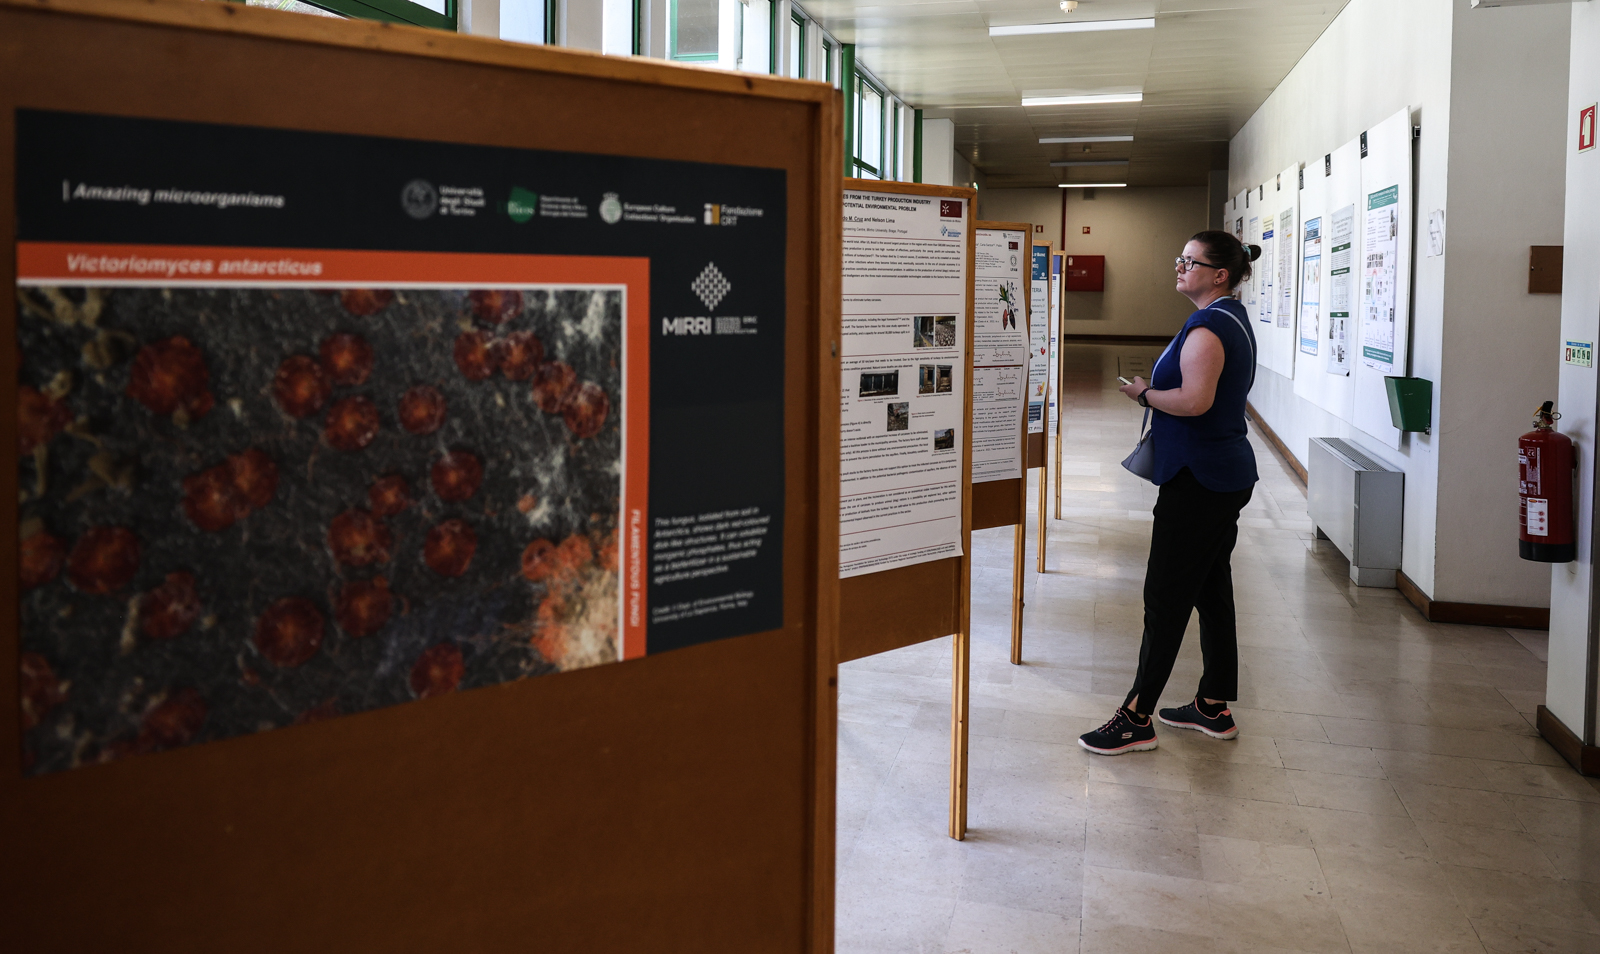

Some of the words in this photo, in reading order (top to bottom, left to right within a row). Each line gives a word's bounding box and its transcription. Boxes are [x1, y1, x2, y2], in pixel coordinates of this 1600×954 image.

[74, 182, 150, 205] Amazing
[154, 188, 285, 208] microorganisms
[721, 204, 764, 216] Fondazione
[67, 254, 214, 277] Victoriomyces
[218, 258, 324, 276] antarcticus
[662, 316, 712, 336] MIRRI
[630, 509, 641, 590] FILAMENTOUS
[630, 594, 640, 627] FUNGI
